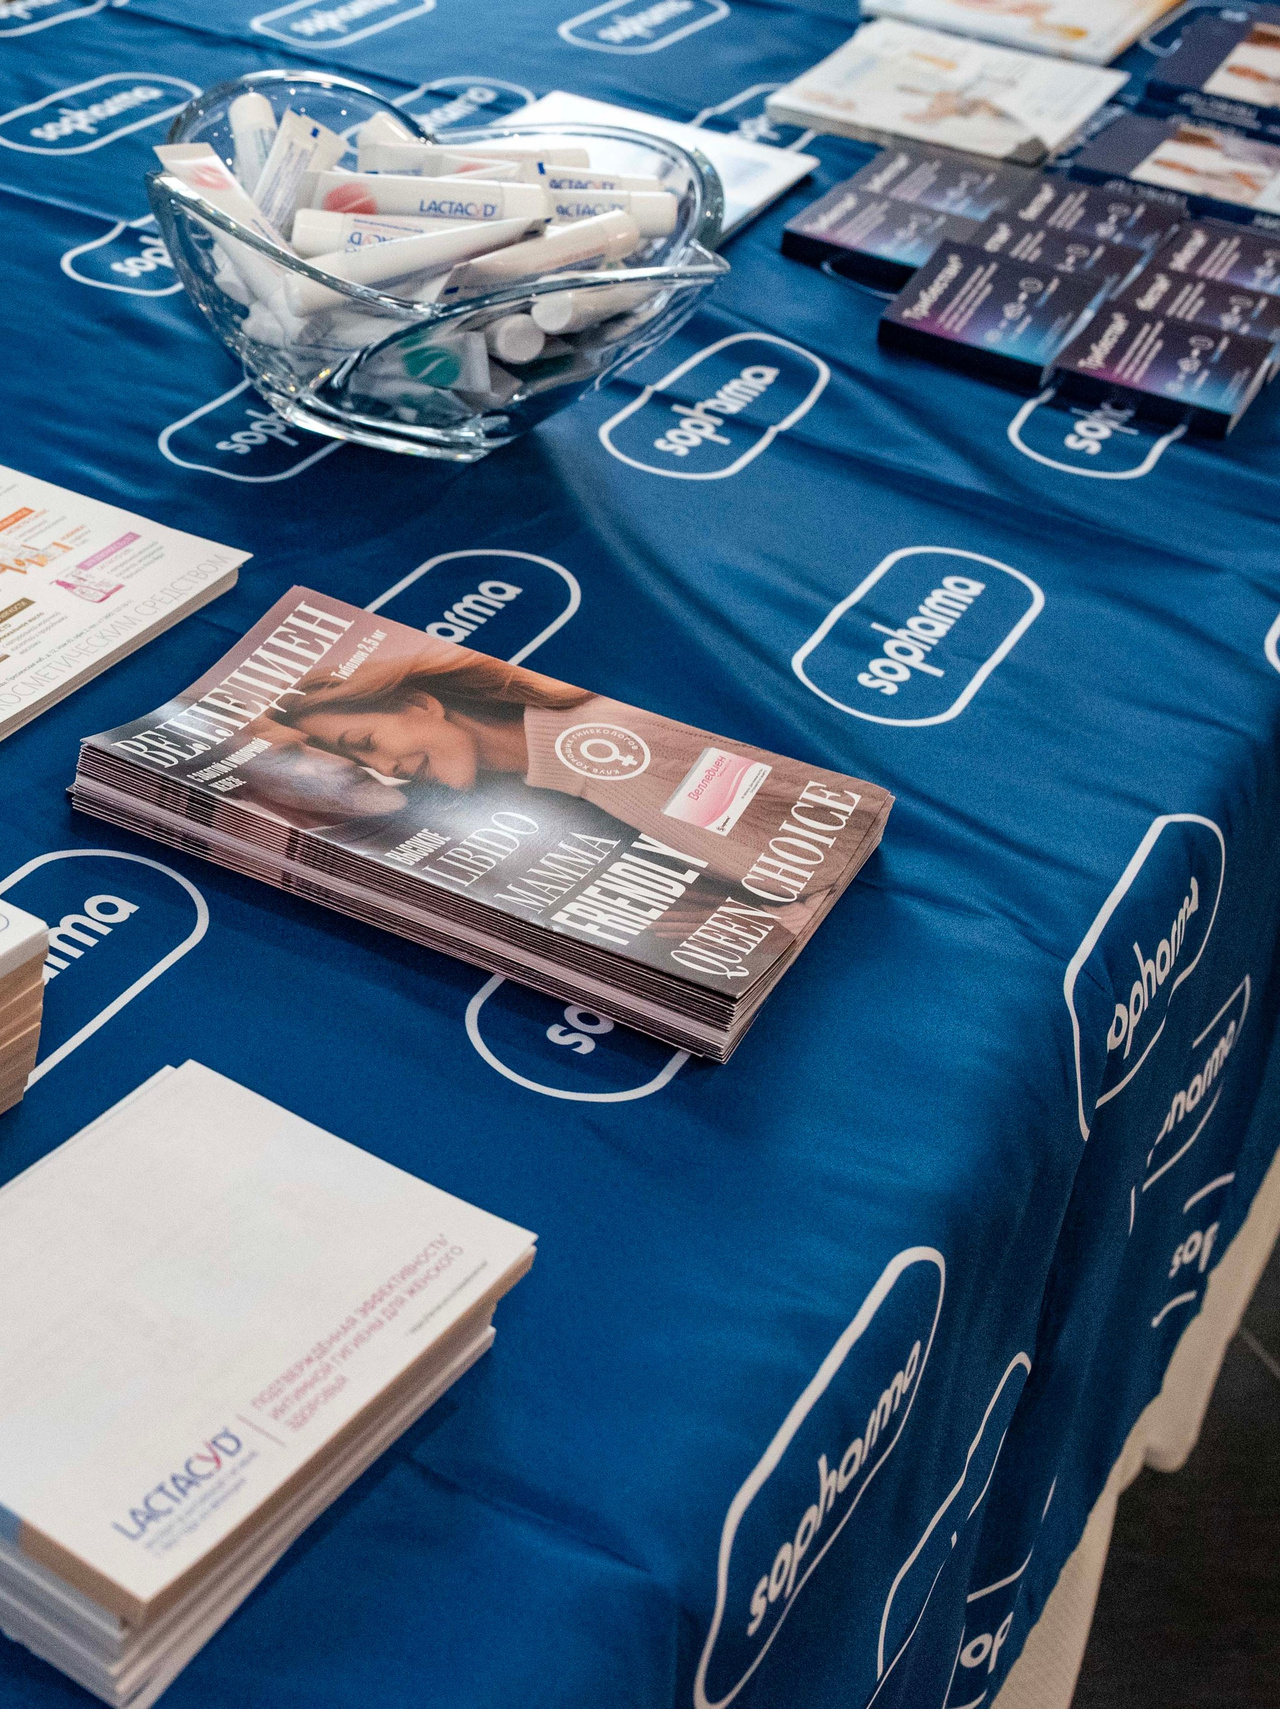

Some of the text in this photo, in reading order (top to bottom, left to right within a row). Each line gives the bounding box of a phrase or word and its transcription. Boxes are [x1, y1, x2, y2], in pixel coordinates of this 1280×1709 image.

[30, 86, 165, 141] sopharma
[419, 199, 497, 218] LACTACYD
[653, 363, 780, 457] sopharma
[131, 554, 236, 616] СРЕДСТВОМ
[423, 580, 523, 643] arma
[331, 646, 370, 680] Тиболон
[856, 573, 986, 697] sopharma
[110, 600, 355, 769] ВЕЛЛЕДИЕН
[564, 738, 591, 771] ХОРОШИХ
[571, 727, 640, 751] ГИНЕКОЛОГОВ
[592, 767, 621, 776] КЛУБ
[687, 755, 727, 801] Велледиен
[384, 827, 452, 867] ВЫСОКОЕ
[421, 810, 540, 888] LIBIDO
[549, 832, 710, 946] FRIENDLY
[670, 779, 863, 980] QUEEN CHOICE
[1107, 877, 1199, 1060] opharma
[111, 1424, 242, 1541] LACTACYD
[748, 1338, 921, 1637] sopharma
